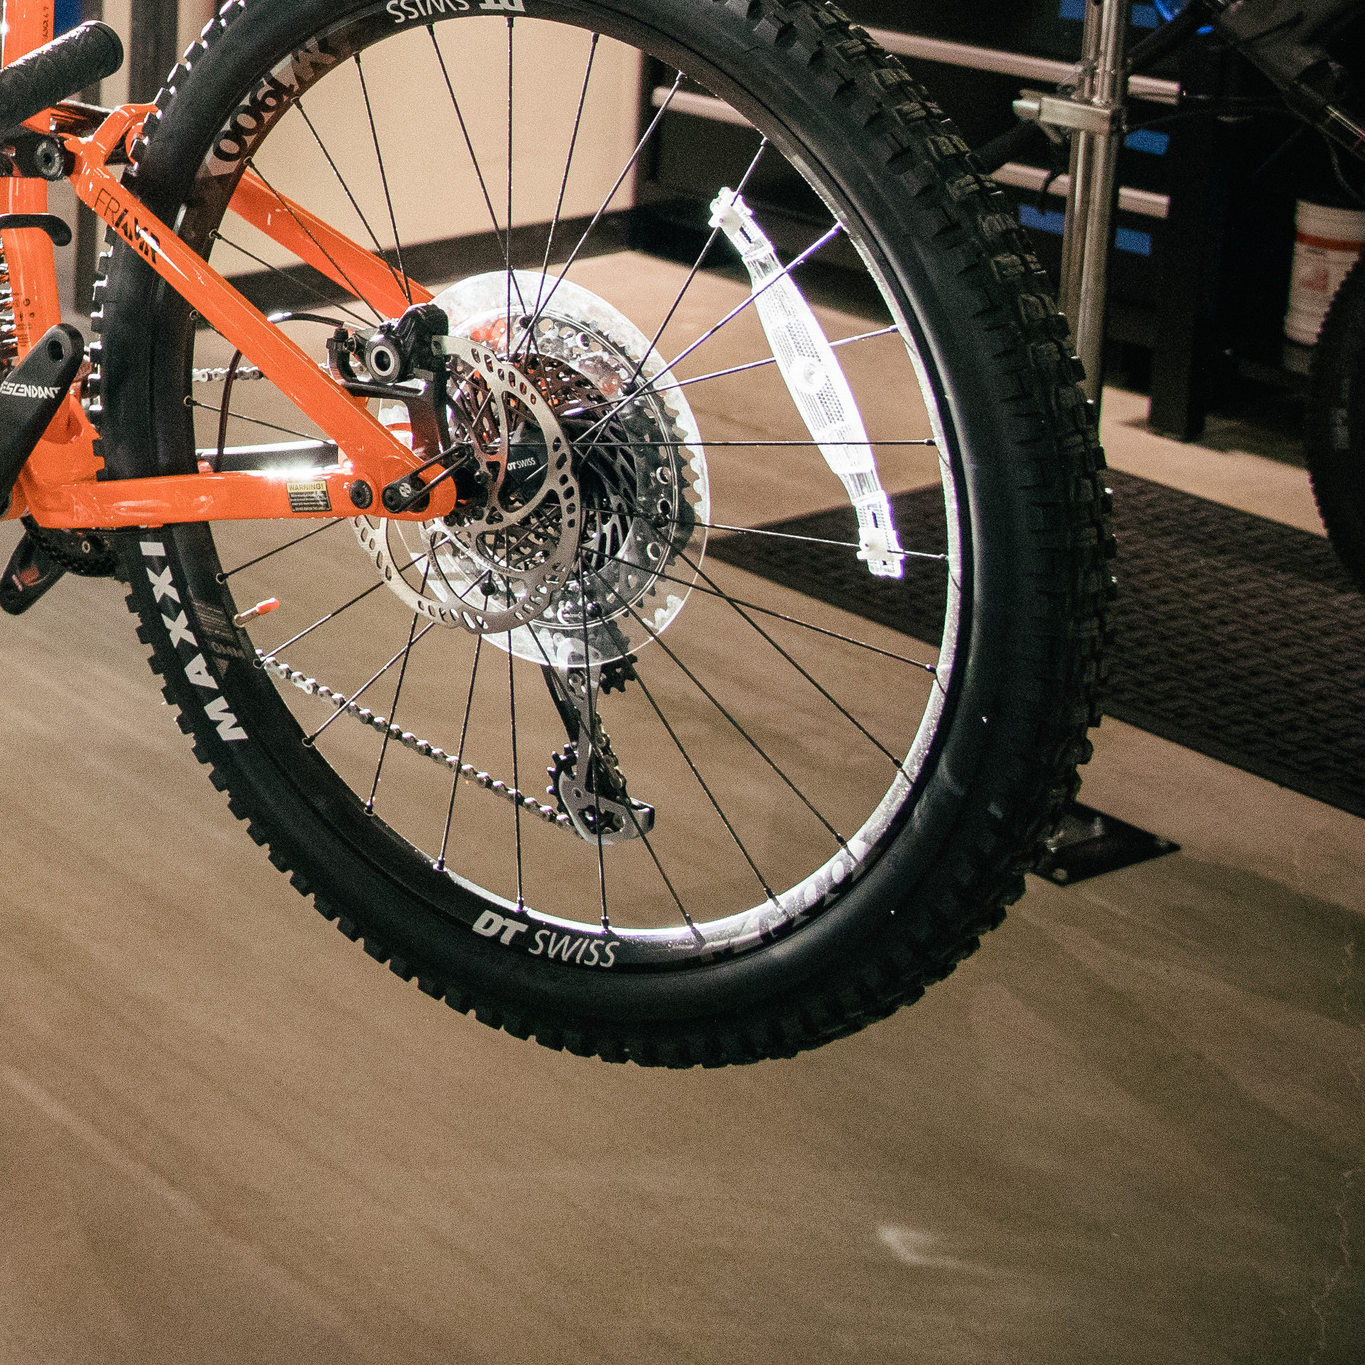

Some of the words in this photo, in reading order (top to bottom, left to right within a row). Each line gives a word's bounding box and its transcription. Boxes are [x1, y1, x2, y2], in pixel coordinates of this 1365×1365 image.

[516, 456, 536, 469] SWISS
[139, 541, 249, 742] MAXXI
[472, 909, 529, 946] DT
[528, 929, 620, 968] SWISS
